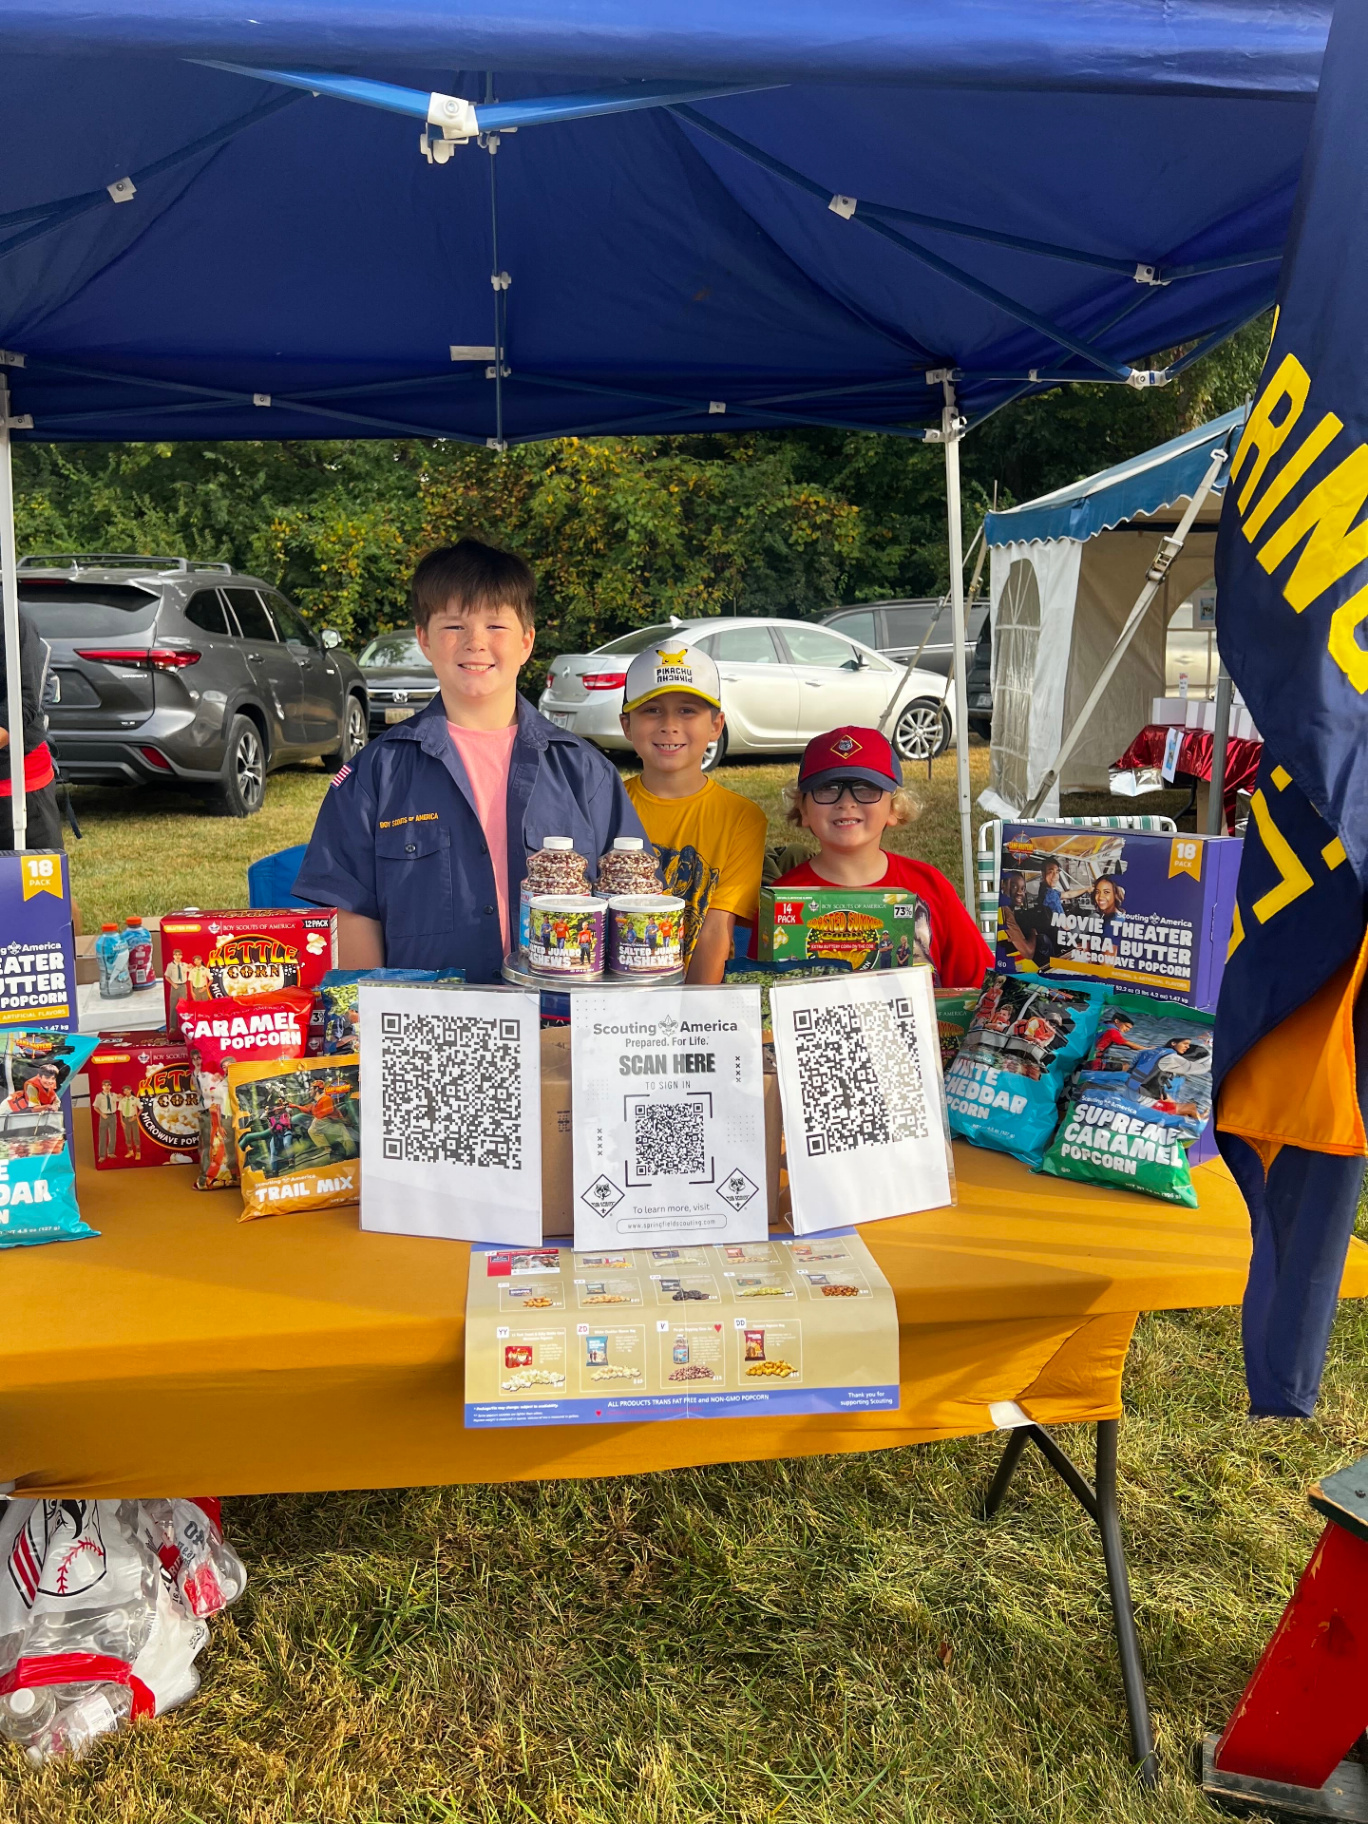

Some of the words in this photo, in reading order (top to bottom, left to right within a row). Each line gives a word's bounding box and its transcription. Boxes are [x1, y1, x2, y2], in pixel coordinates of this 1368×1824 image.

[656, 667, 692, 676] PIKACHU
[392, 817, 408, 827] SCOUTS
[415, 812, 439, 822] AMERICA
[1176, 842, 1197, 860] 18
[28, 859, 54, 878] 18
[1174, 860, 1192, 868] PACK
[29, 878, 52, 887] PACK
[783, 903, 793, 914] 14
[894, 906, 913, 916] 73%
[777, 914, 796, 924] PACK
[1117, 912, 1149, 923] Scouting
[1160, 917, 1193, 928] America
[821, 931, 863, 941] CORN
[1051, 912, 1104, 934] MOVIE
[1110, 920, 1193, 946] THEATER
[22, 942, 62, 952] America
[208, 939, 299, 967] KETTLE
[548, 947, 581, 957] JUMBO
[619, 946, 652, 956] SALTED
[1057, 930, 1114, 953] EXTRA
[1120, 940, 1192, 965] BUTTER
[619, 955, 674, 966] CASHEWS
[1071, 949, 1135, 968] MICROWAVE
[1138, 960, 1191, 978] POPCORN
[226, 964, 281, 979] CORN
[0, 991, 68, 1009] POPCORN
[2, 1012, 36, 1020] ARTIFICIAL
[38, 1009, 66, 1017] FLAVORS
[181, 1012, 300, 1040] CARAMEL
[593, 1021, 657, 1036] Scouting
[680, 1019, 738, 1033] America
[220, 1031, 302, 1050] POPCORN
[625, 1037, 670, 1049] Prepared.
[672, 1036, 686, 1046] For
[689, 1035, 709, 1046] Life.
[619, 1054, 667, 1076] SCAN
[673, 1053, 716, 1074] HERE
[949, 1058, 1000, 1086] WHITE
[645, 1081, 656, 1090] TO
[659, 1080, 679, 1090] SIGN
[682, 1080, 691, 1089] IN
[157, 1092, 199, 1108] COR
[1110, 1102, 1137, 1115] America
[141, 1112, 178, 1145] MICROWAVE
[1073, 1103, 1181, 1145] SUPREME
[1064, 1123, 1183, 1168] CARAMEL
[1061, 1143, 1137, 1175] POPCORN
[255, 1182, 310, 1203] TRAIL
[317, 1176, 353, 1194] MIX
[633, 1206, 643, 1214] To
[644, 1205, 666, 1214] learn
[667, 1206, 691, 1215] more,
[693, 1203, 710, 1212] visit
[627, 1218, 716, 1230] www.springfieldscouting.com
[840, 1398, 870, 1407] supporting
[870, 1397, 893, 1406] Scouting
[848, 1391, 865, 1399] Thank
[866, 1392, 876, 1400] you
